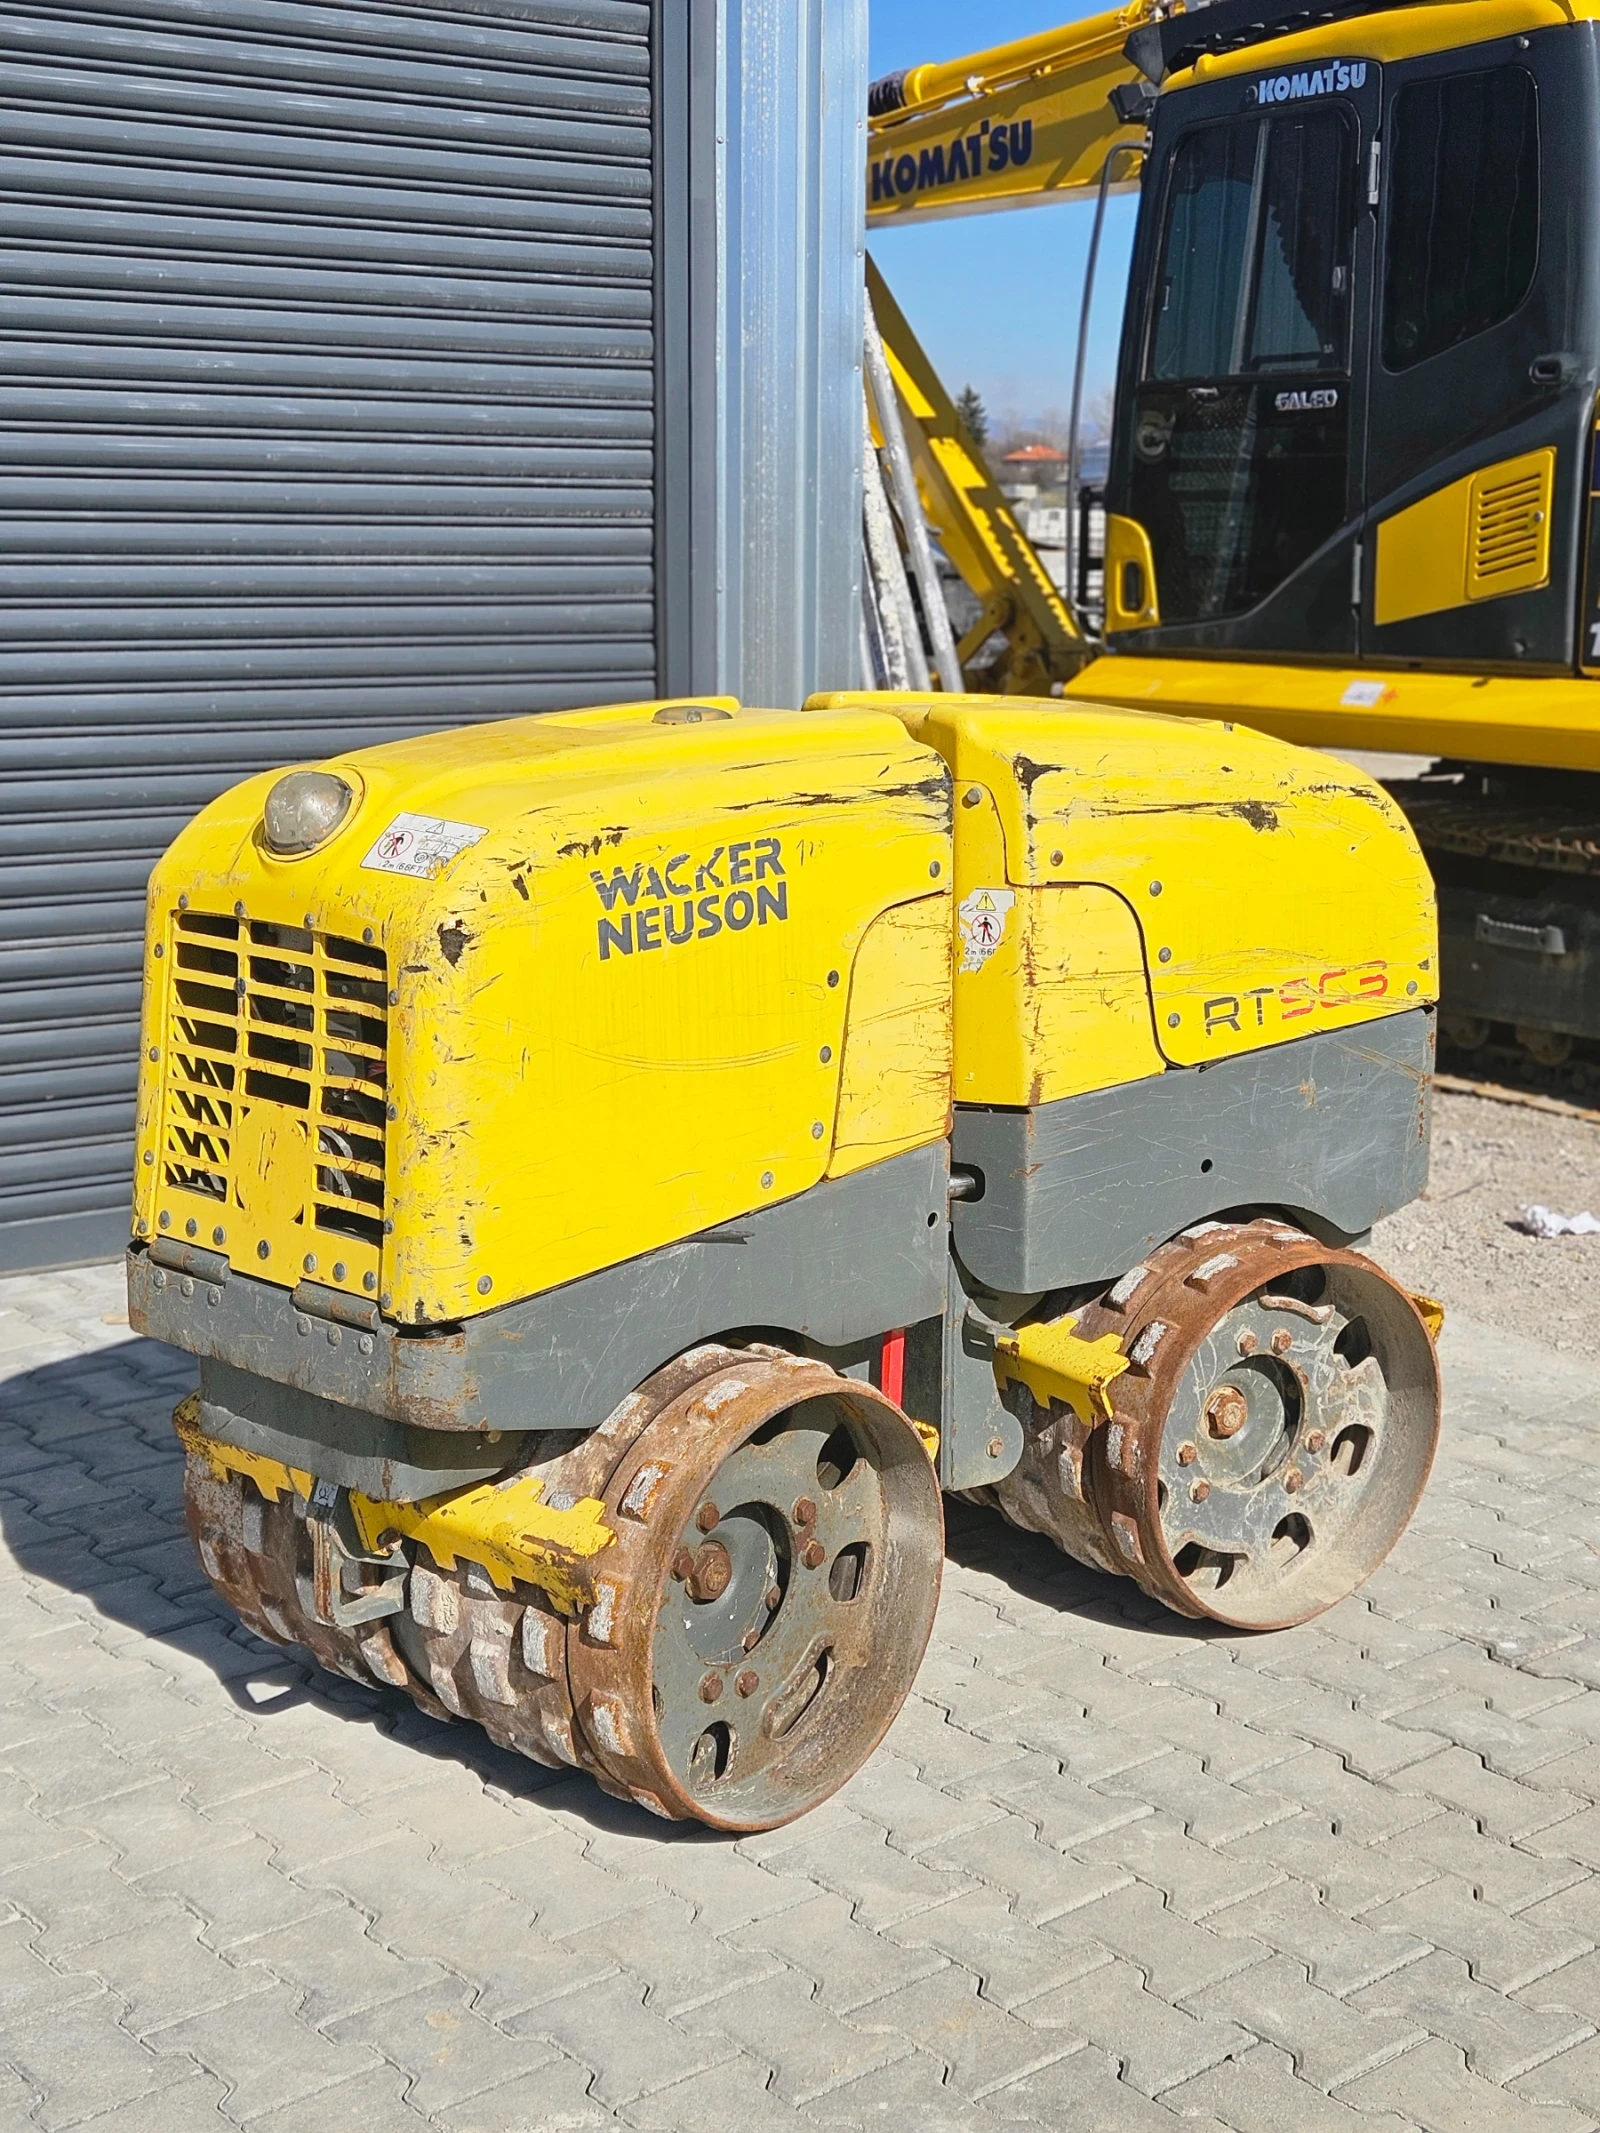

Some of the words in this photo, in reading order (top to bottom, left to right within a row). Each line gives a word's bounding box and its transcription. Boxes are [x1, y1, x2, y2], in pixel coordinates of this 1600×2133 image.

[1258, 60, 1367, 104] KOMATSU
[871, 119, 1032, 202] KOMATSU
[1274, 389, 1338, 411] GALEO
[589, 838, 786, 911] WACKER
[597, 881, 788, 961] NEUSON
